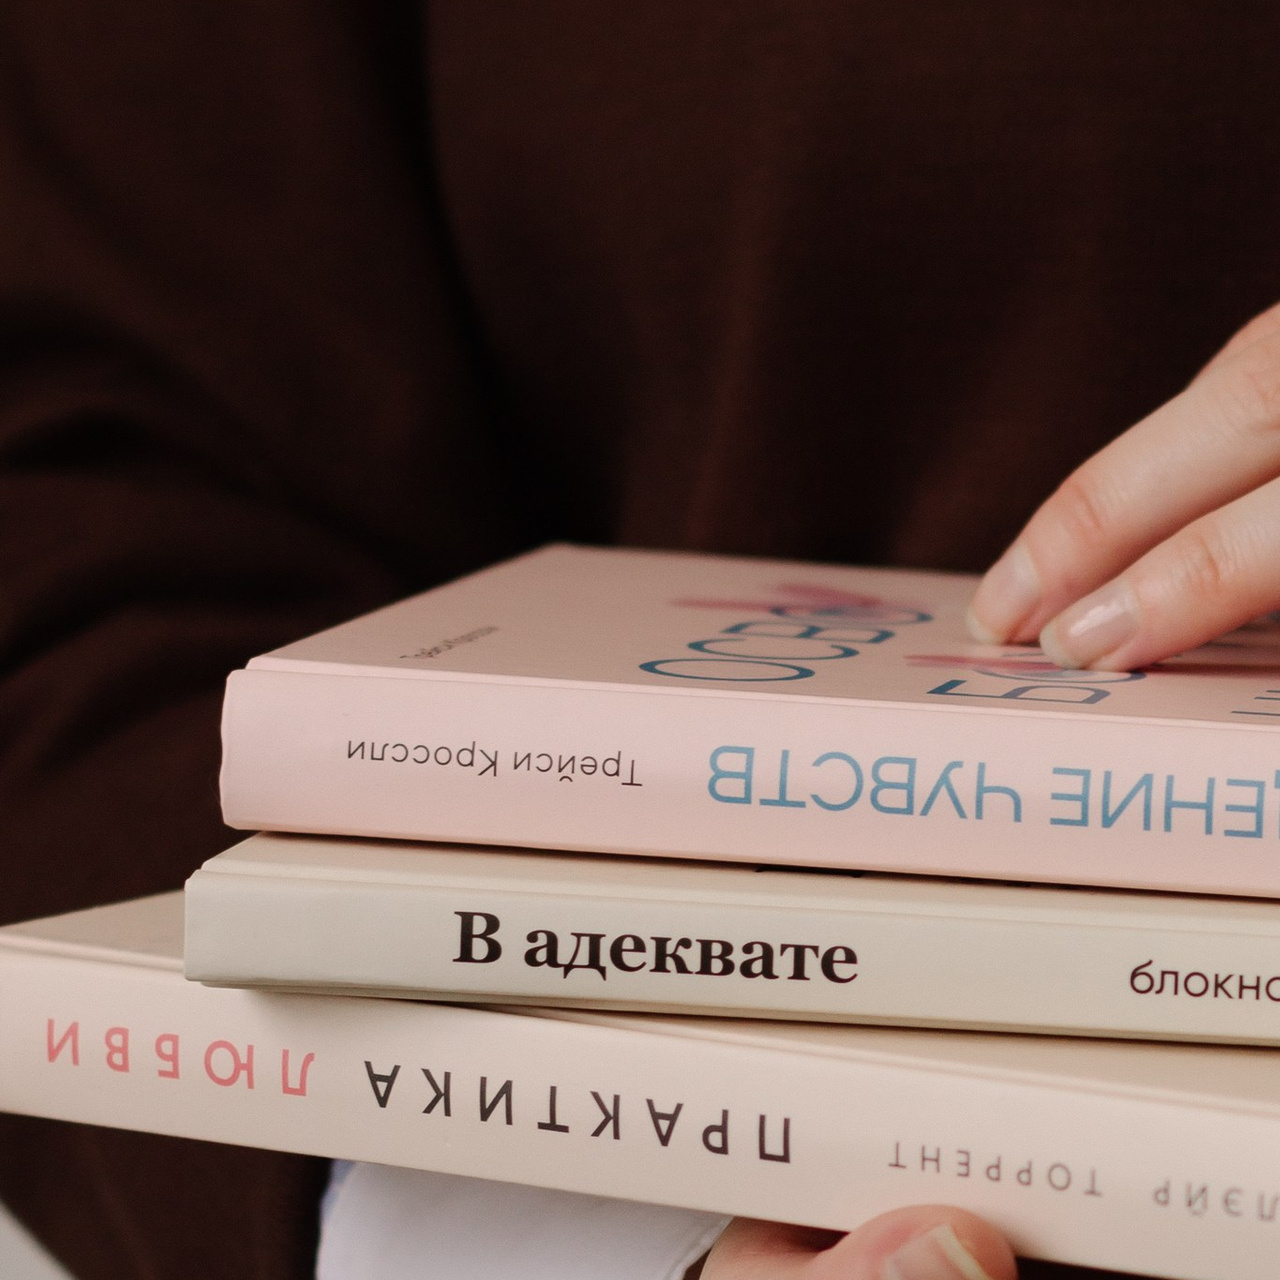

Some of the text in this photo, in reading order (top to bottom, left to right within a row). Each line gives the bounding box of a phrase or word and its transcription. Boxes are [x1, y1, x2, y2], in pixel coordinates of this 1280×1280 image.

[347, 740, 644, 787] Трейси Кроссли
[707, 745, 1022, 823] ЧУВСТВ
[451, 910, 860, 984] В адеквате
[46, 1017, 792, 1165] ПРАКТИКА ЛЮБВИ
[887, 1141, 1104, 1199] ТОРРЕНТ
